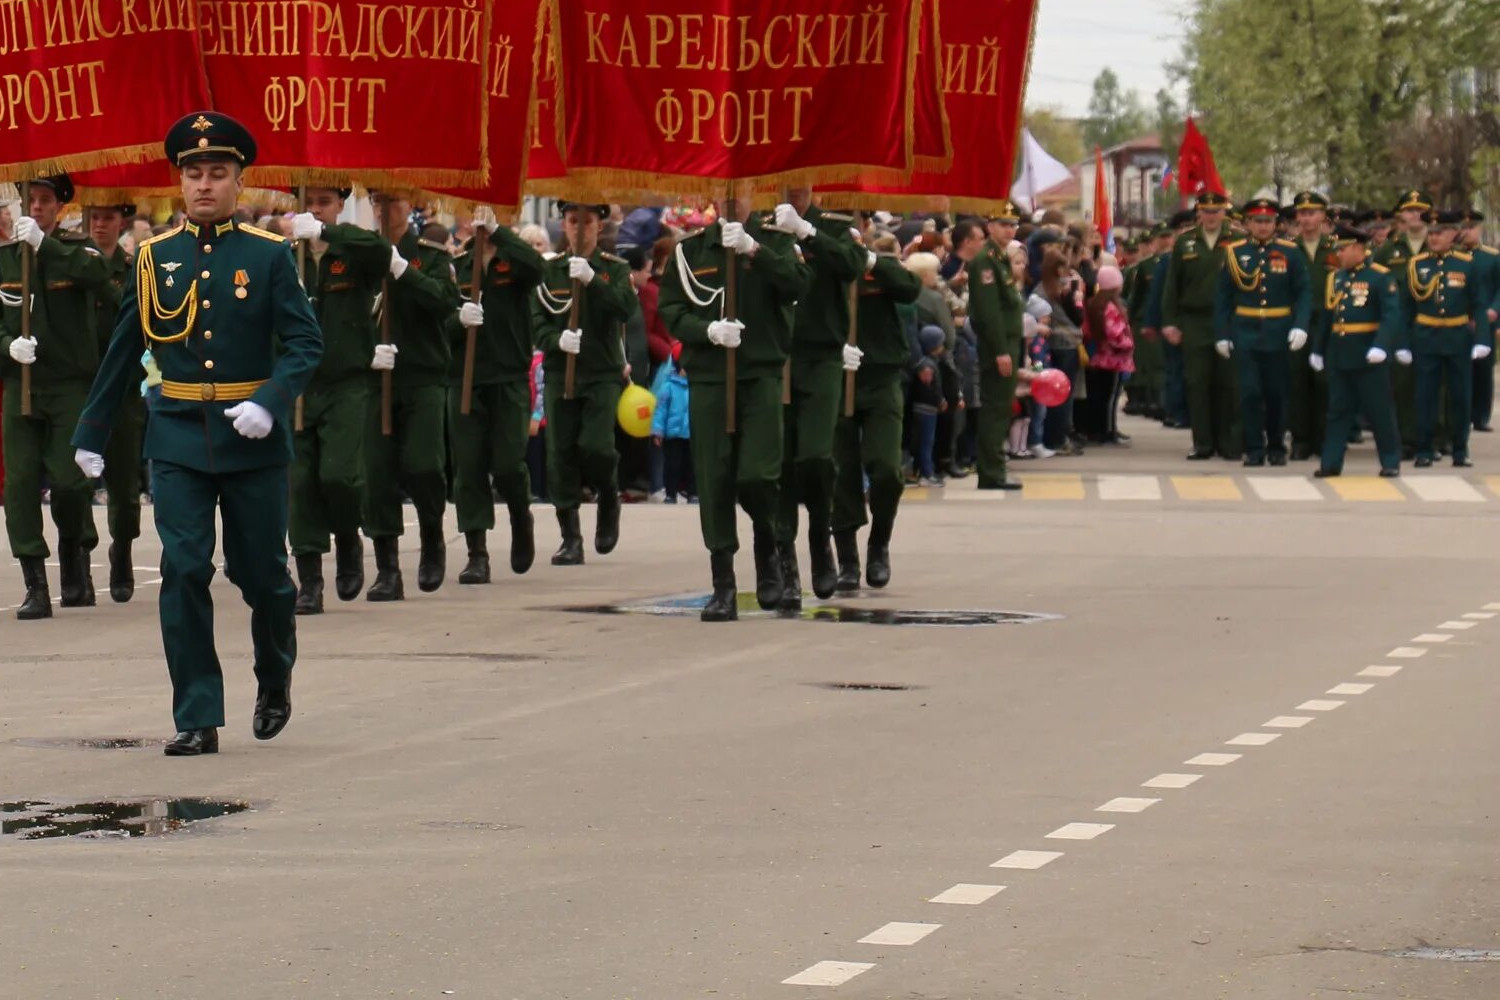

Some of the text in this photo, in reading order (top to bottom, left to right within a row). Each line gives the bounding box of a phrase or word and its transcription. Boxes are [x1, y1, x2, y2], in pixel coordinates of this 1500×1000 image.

[586, 4, 888, 72] КАРЕЛЬСКИЙ
[263, 76, 386, 133] ФРОНТ
[655, 87, 813, 148] ФРОНТ
